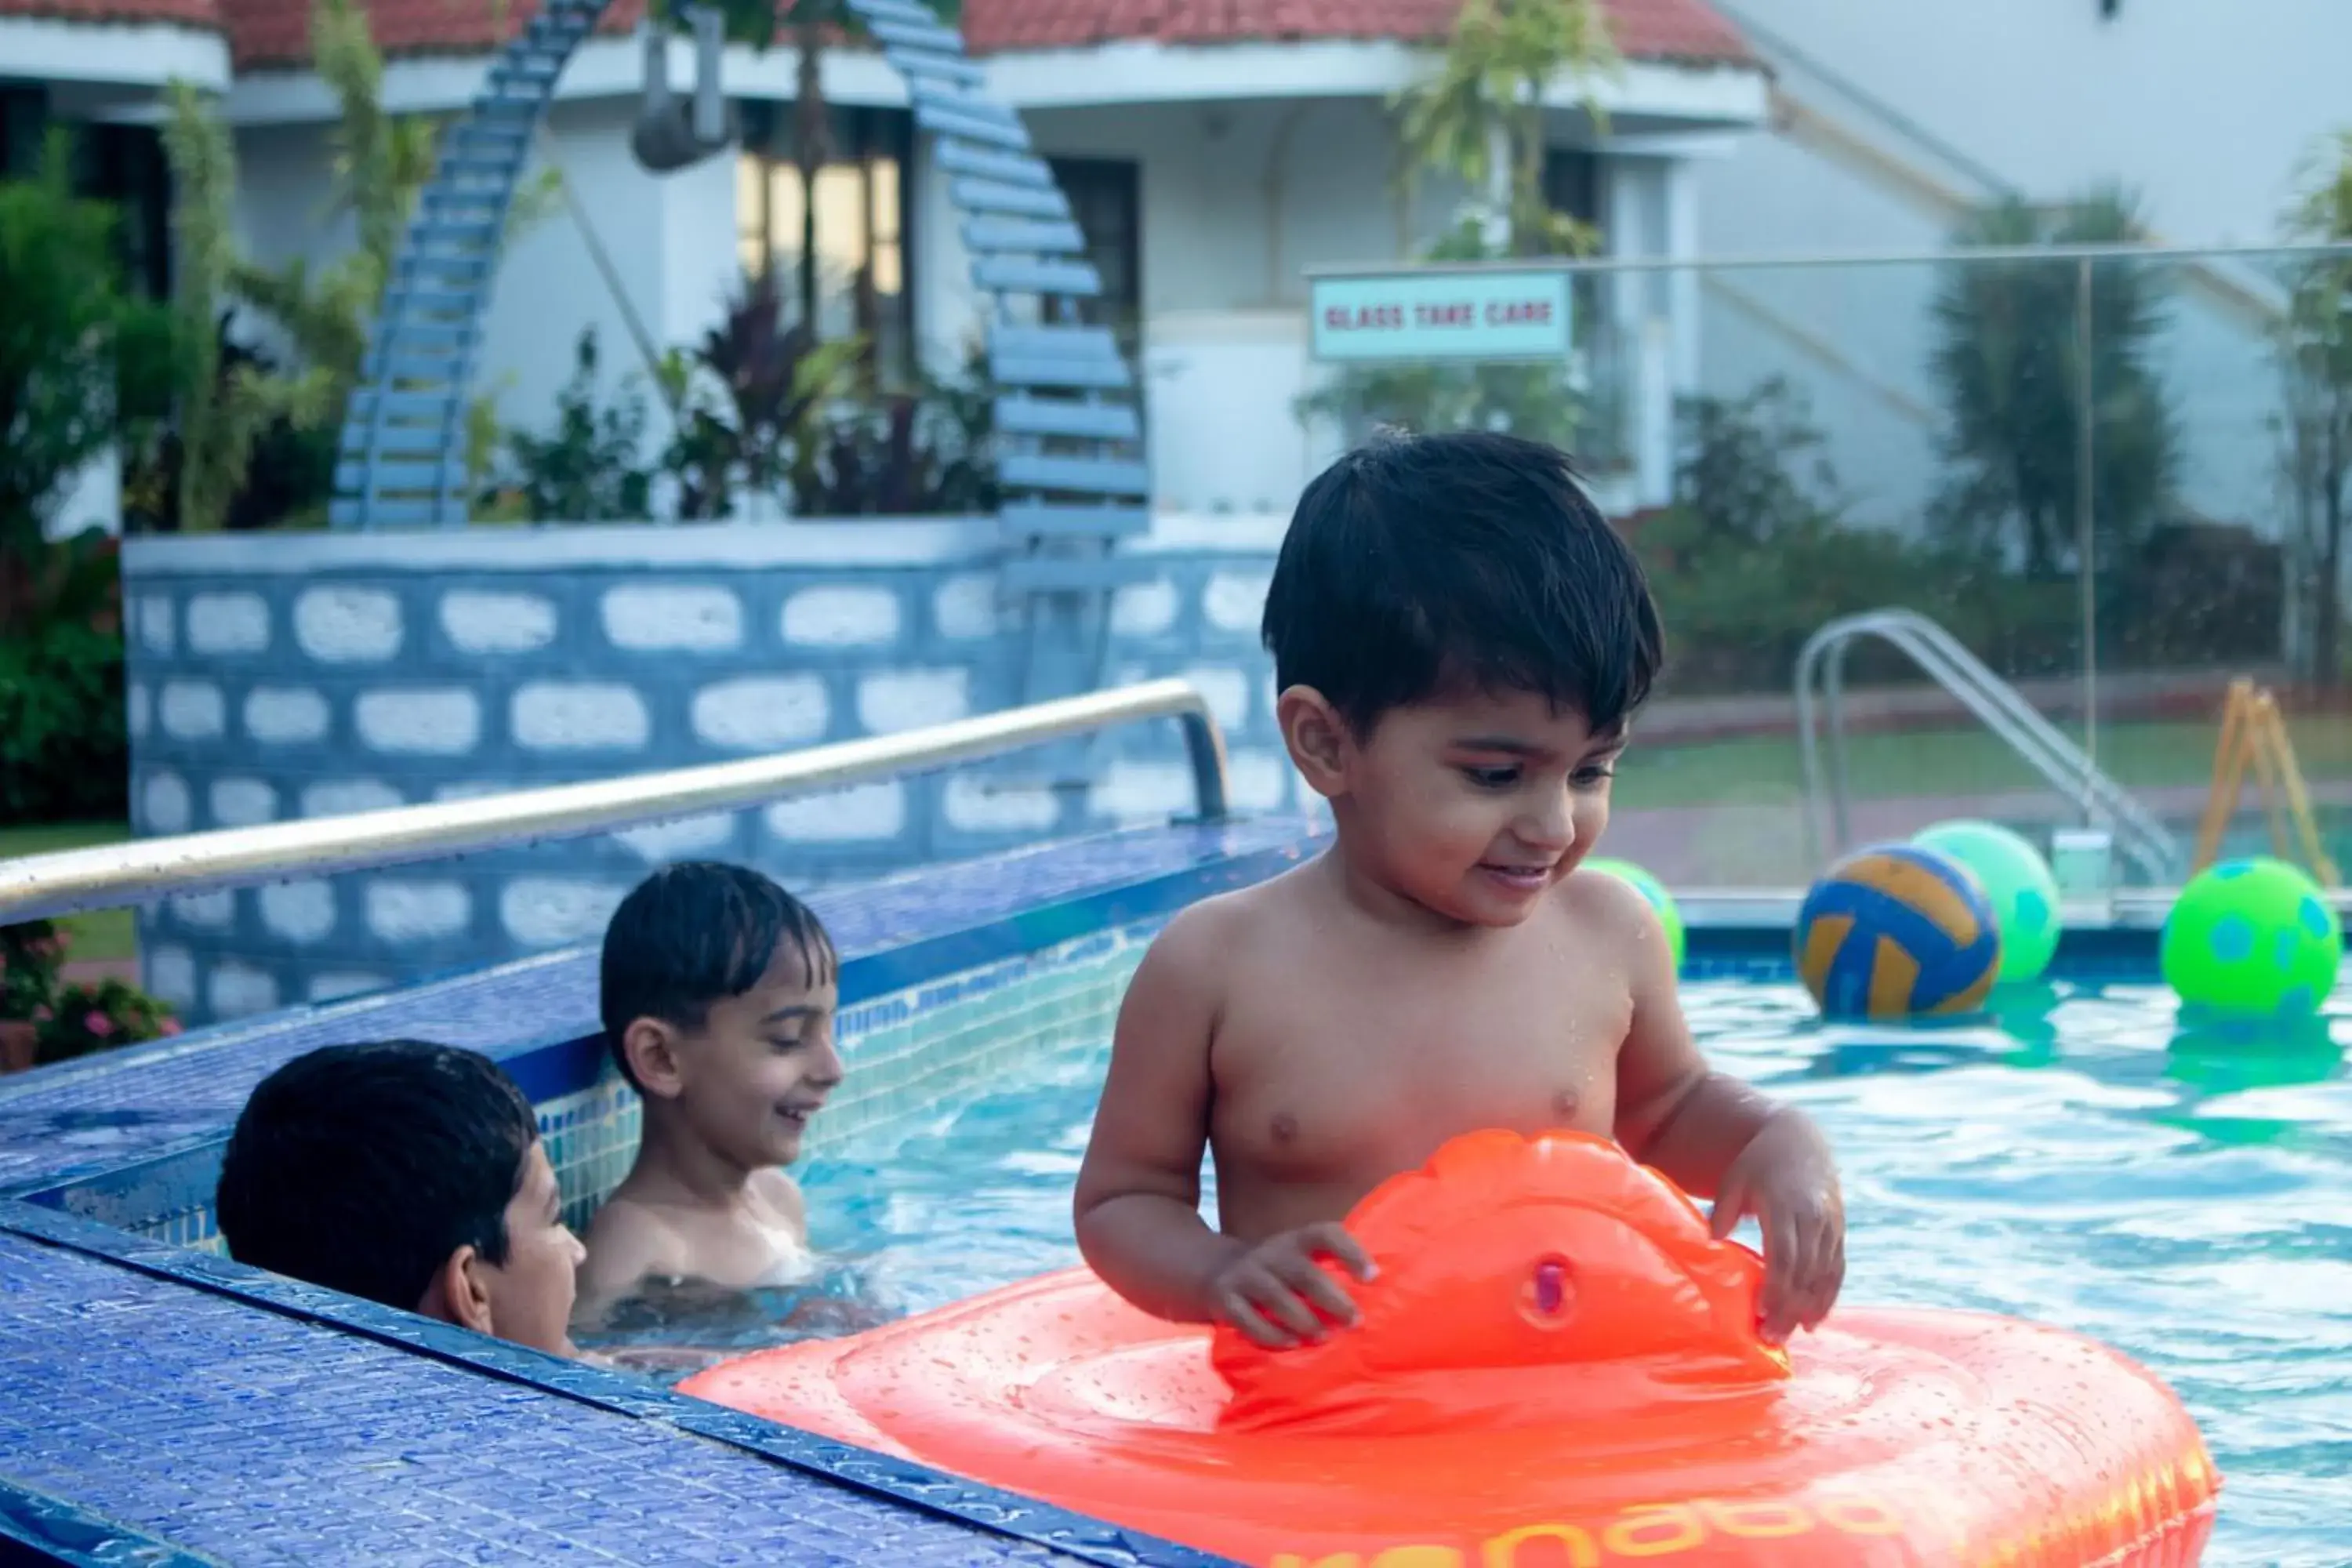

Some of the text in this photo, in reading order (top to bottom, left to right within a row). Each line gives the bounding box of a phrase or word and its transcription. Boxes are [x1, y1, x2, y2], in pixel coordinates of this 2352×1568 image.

[1325, 299, 1552, 331] GLASS TAKE CARE
